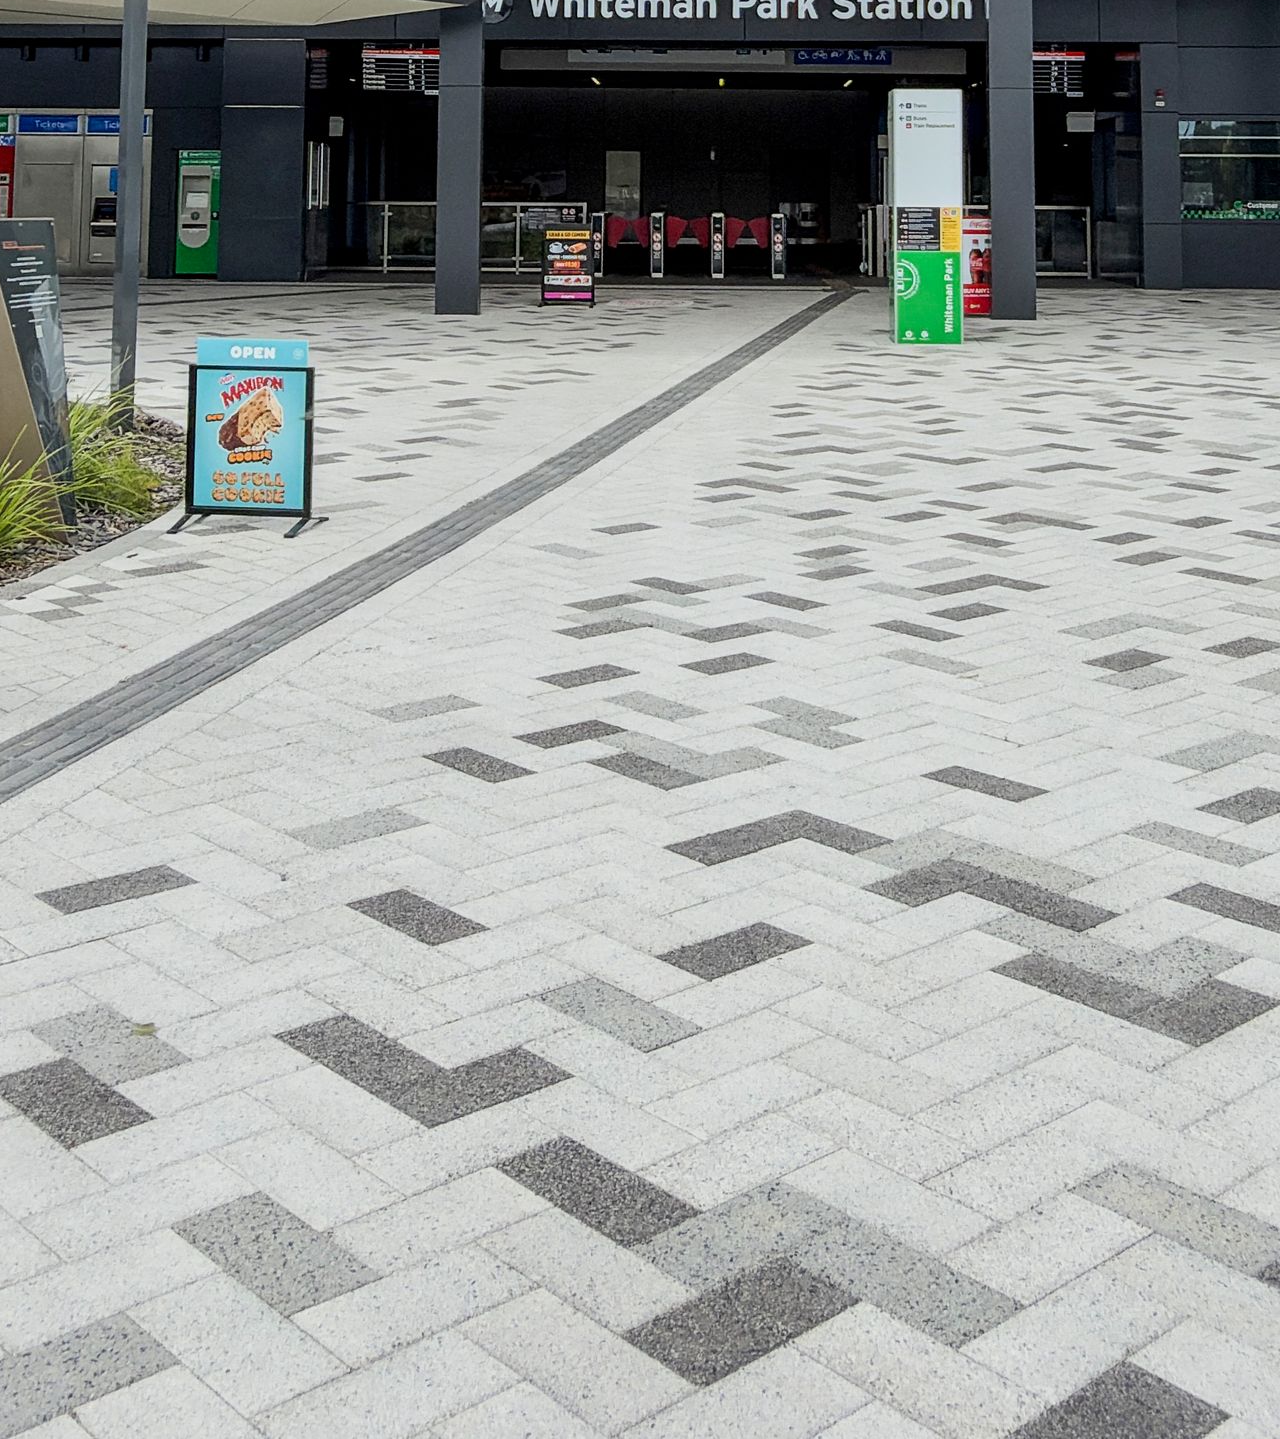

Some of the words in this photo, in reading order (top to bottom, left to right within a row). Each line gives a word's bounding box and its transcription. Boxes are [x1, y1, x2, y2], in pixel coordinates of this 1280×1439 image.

[35, 119, 65, 129] Tickets
[943, 257, 954, 282] Park
[943, 284, 954, 334] Whiteman
[230, 346, 276, 360] OPEN
[221, 376, 285, 408] MAXIBON
[228, 450, 272, 464] COOKIE
[212, 487, 285, 504] COOKIE
